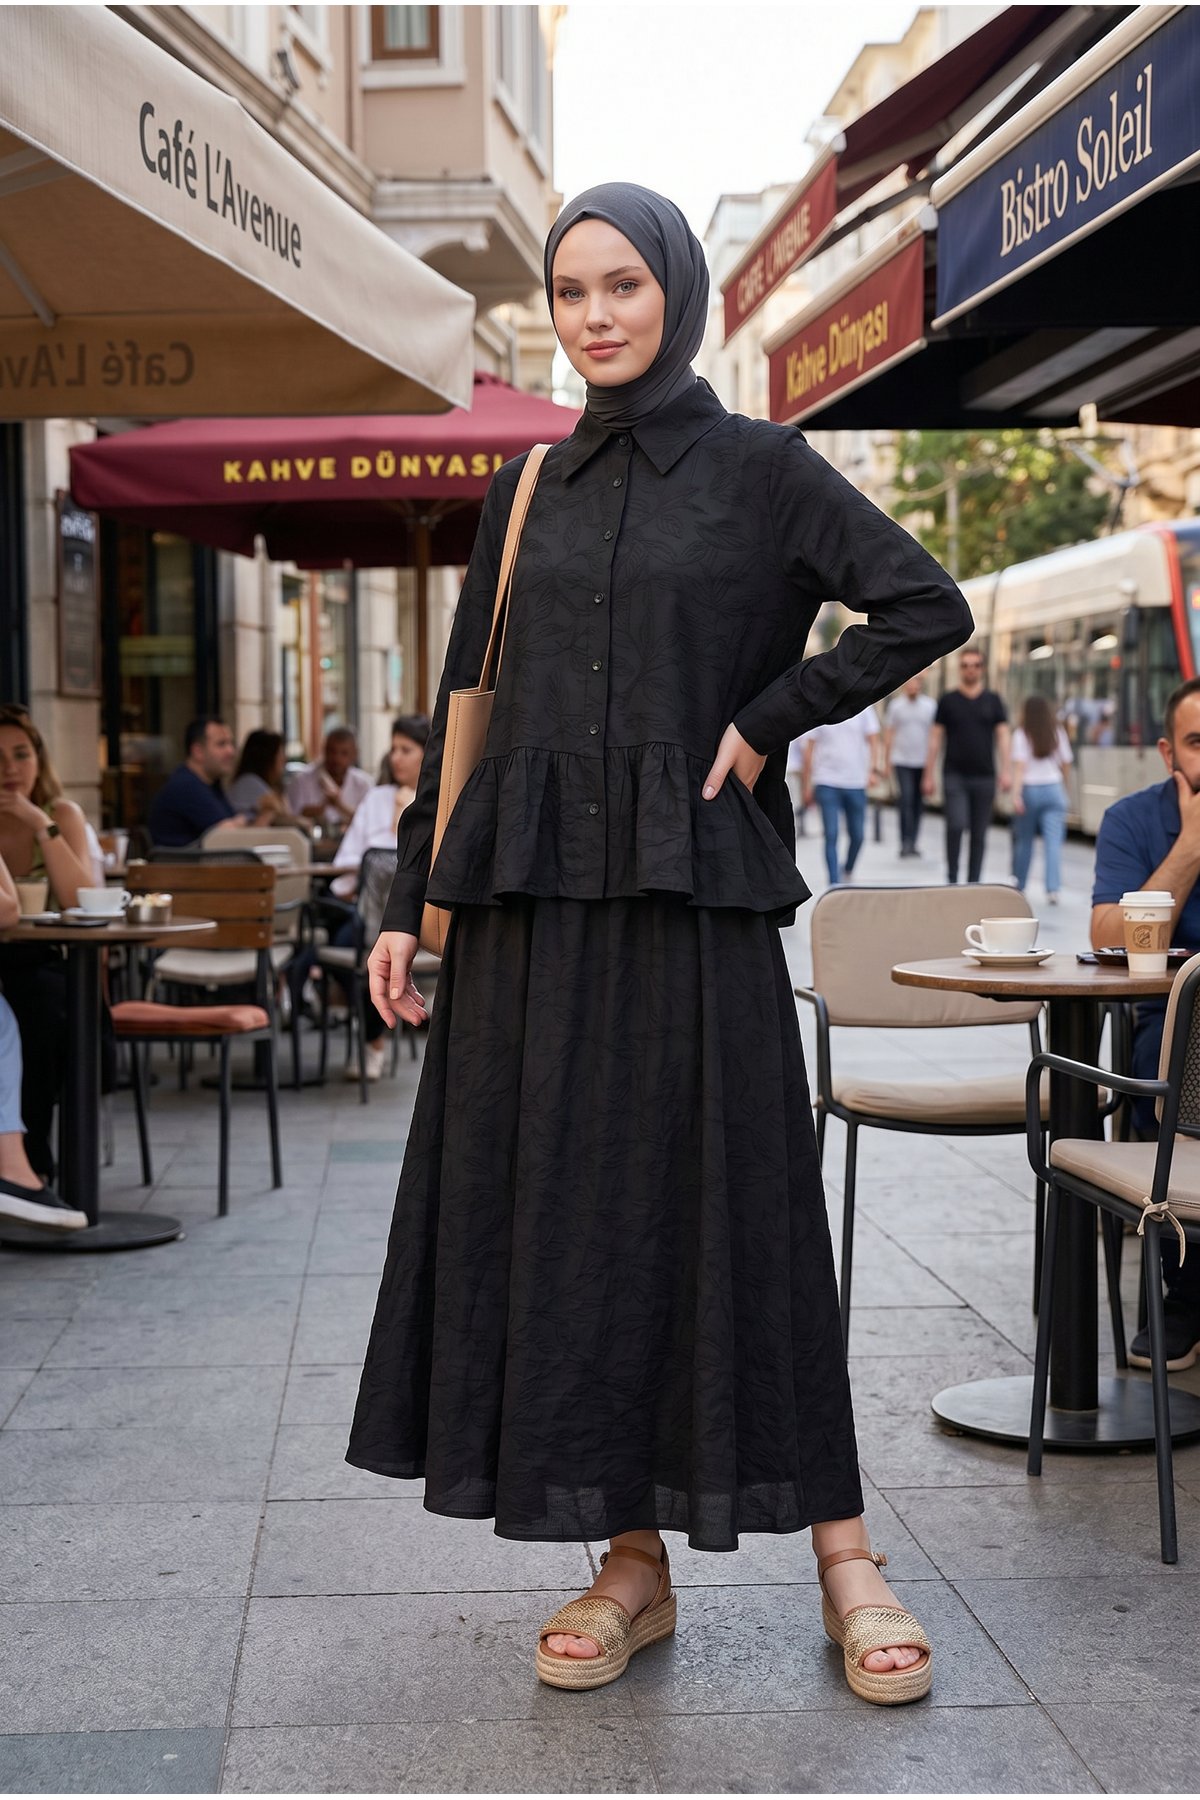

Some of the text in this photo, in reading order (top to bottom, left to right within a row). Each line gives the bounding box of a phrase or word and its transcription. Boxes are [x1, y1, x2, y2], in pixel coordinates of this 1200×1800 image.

[140, 101, 302, 269] Café L'Avenue
[1001, 63, 1153, 257] Bistro Soleil
[786, 300, 888, 404] Kahve Dünyası
[223, 450, 503, 483] KAHVE DÜNYASI
